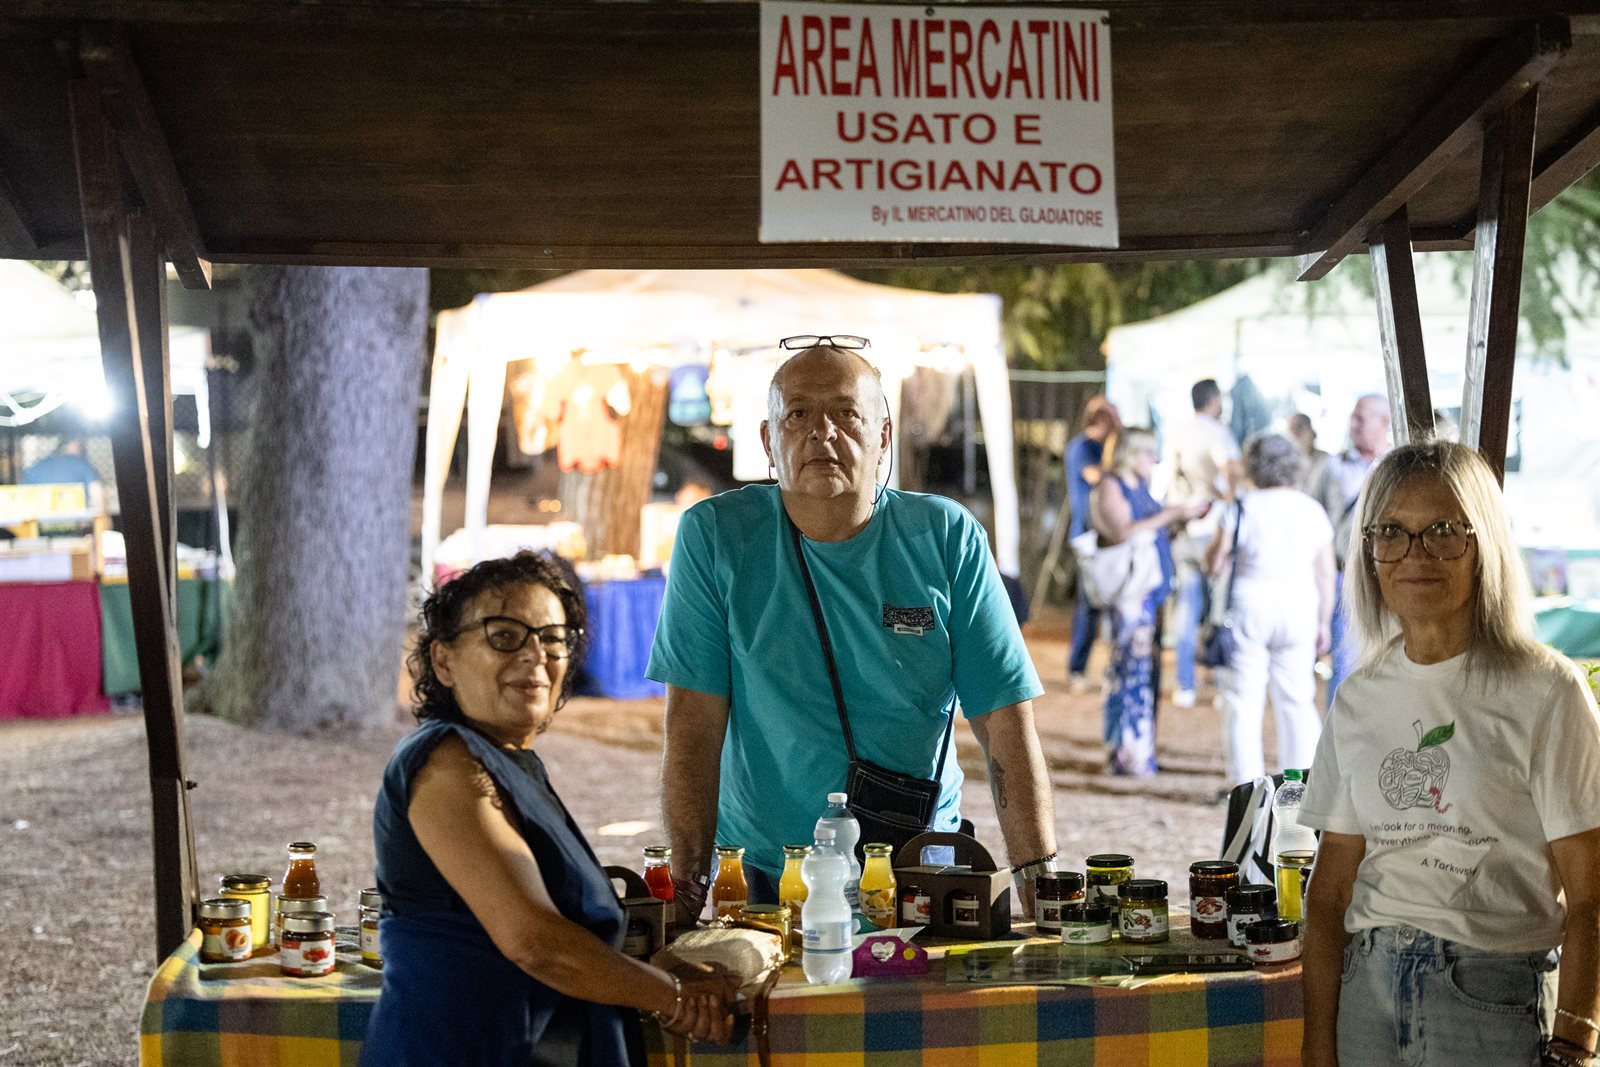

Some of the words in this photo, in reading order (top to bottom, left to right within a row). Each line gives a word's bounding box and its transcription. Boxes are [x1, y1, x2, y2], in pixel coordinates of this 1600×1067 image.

[773, 14, 882, 97] AREA
[891, 18, 1100, 102] MERCATINI
[837, 111, 997, 145] USATO
[1014, 114, 1042, 145] E
[775, 159, 1103, 195] ARTIGIANATO
[871, 206, 888, 226] By
[892, 206, 904, 222] IL
[907, 206, 987, 223] MERCATINO
[990, 207, 1016, 223] DEL
[1019, 208, 1104, 227] GLADIATORE
[1404, 821, 1416, 832] for
